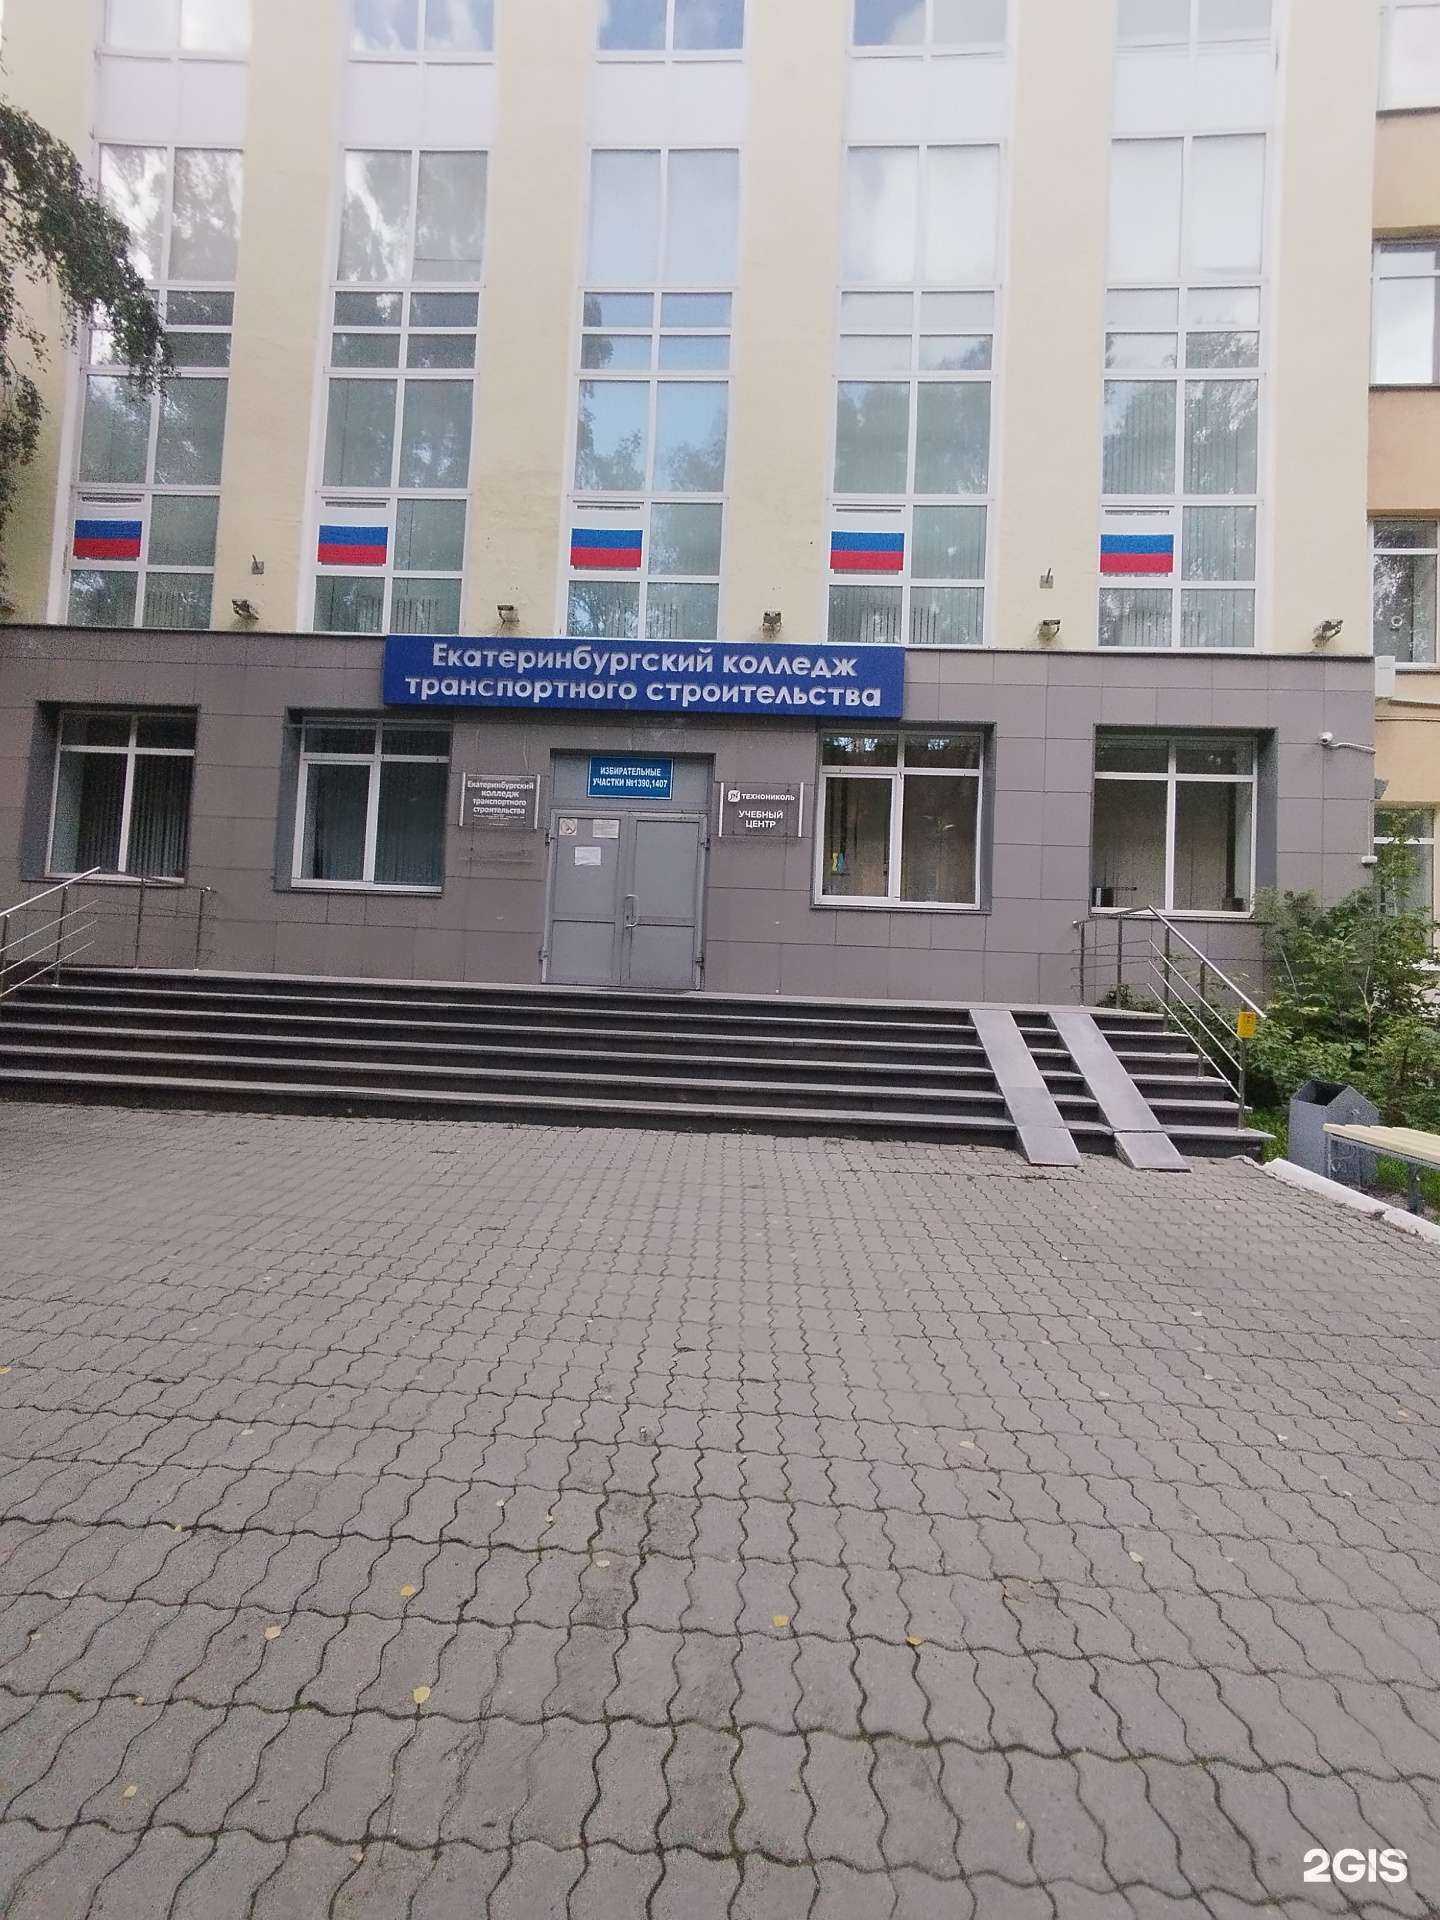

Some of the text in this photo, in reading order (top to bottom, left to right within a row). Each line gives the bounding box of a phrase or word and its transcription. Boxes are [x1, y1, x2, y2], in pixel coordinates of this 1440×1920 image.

[432, 642, 858, 679] Екатеринбургский колледж
[405, 677, 881, 708] транспортного строительства
[600, 766, 662, 776] ИЗБИРАТЕЛЬНЫЕ
[592, 778, 625, 787] УЧАСТКИ
[481, 790, 520, 799] колледж
[741, 793, 796, 801] ТЕХНОНИКОЛЬ
[473, 798, 527, 807] транспортного
[473, 806, 526, 815] строительства
[738, 809, 784, 819] УЧЕБНЫЙ
[745, 820, 777, 829] ЦЕНТР
